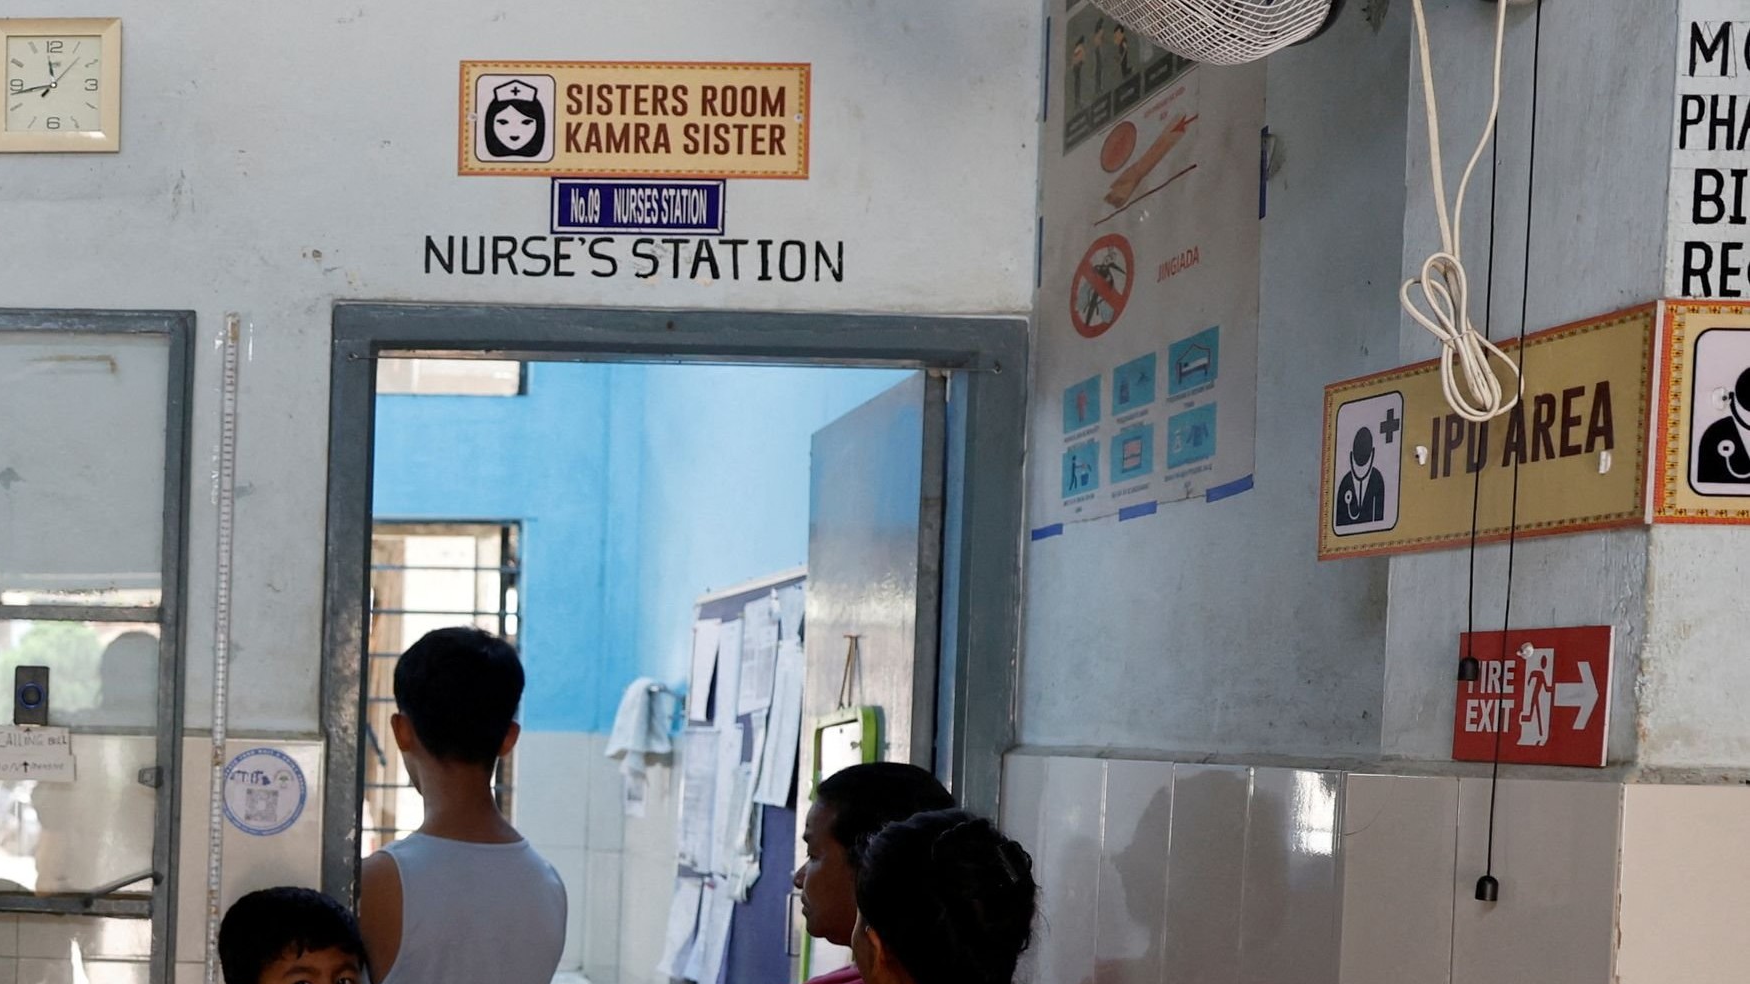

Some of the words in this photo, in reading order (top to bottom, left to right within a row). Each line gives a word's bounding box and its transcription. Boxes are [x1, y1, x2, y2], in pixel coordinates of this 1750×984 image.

[46, 40, 63, 54] 12
[10, 79, 24, 92] 9
[84, 78, 98, 92] 3
[566, 84, 688, 116] SISTERS
[701, 86, 786, 117] ROOM
[46, 117, 60, 130] 6
[566, 122, 672, 154] KAMRA
[683, 124, 786, 156] SISTER
[571, 188, 600, 224] No.09
[614, 189, 658, 224] NURSES
[661, 189, 707, 224] STATION
[425, 236, 617, 277] NURSE'S
[632, 238, 844, 282] STATION
[1430, 413, 1489, 480] IPD
[1502, 380, 1614, 468] AREA
[1465, 700, 1514, 732] EXIT
